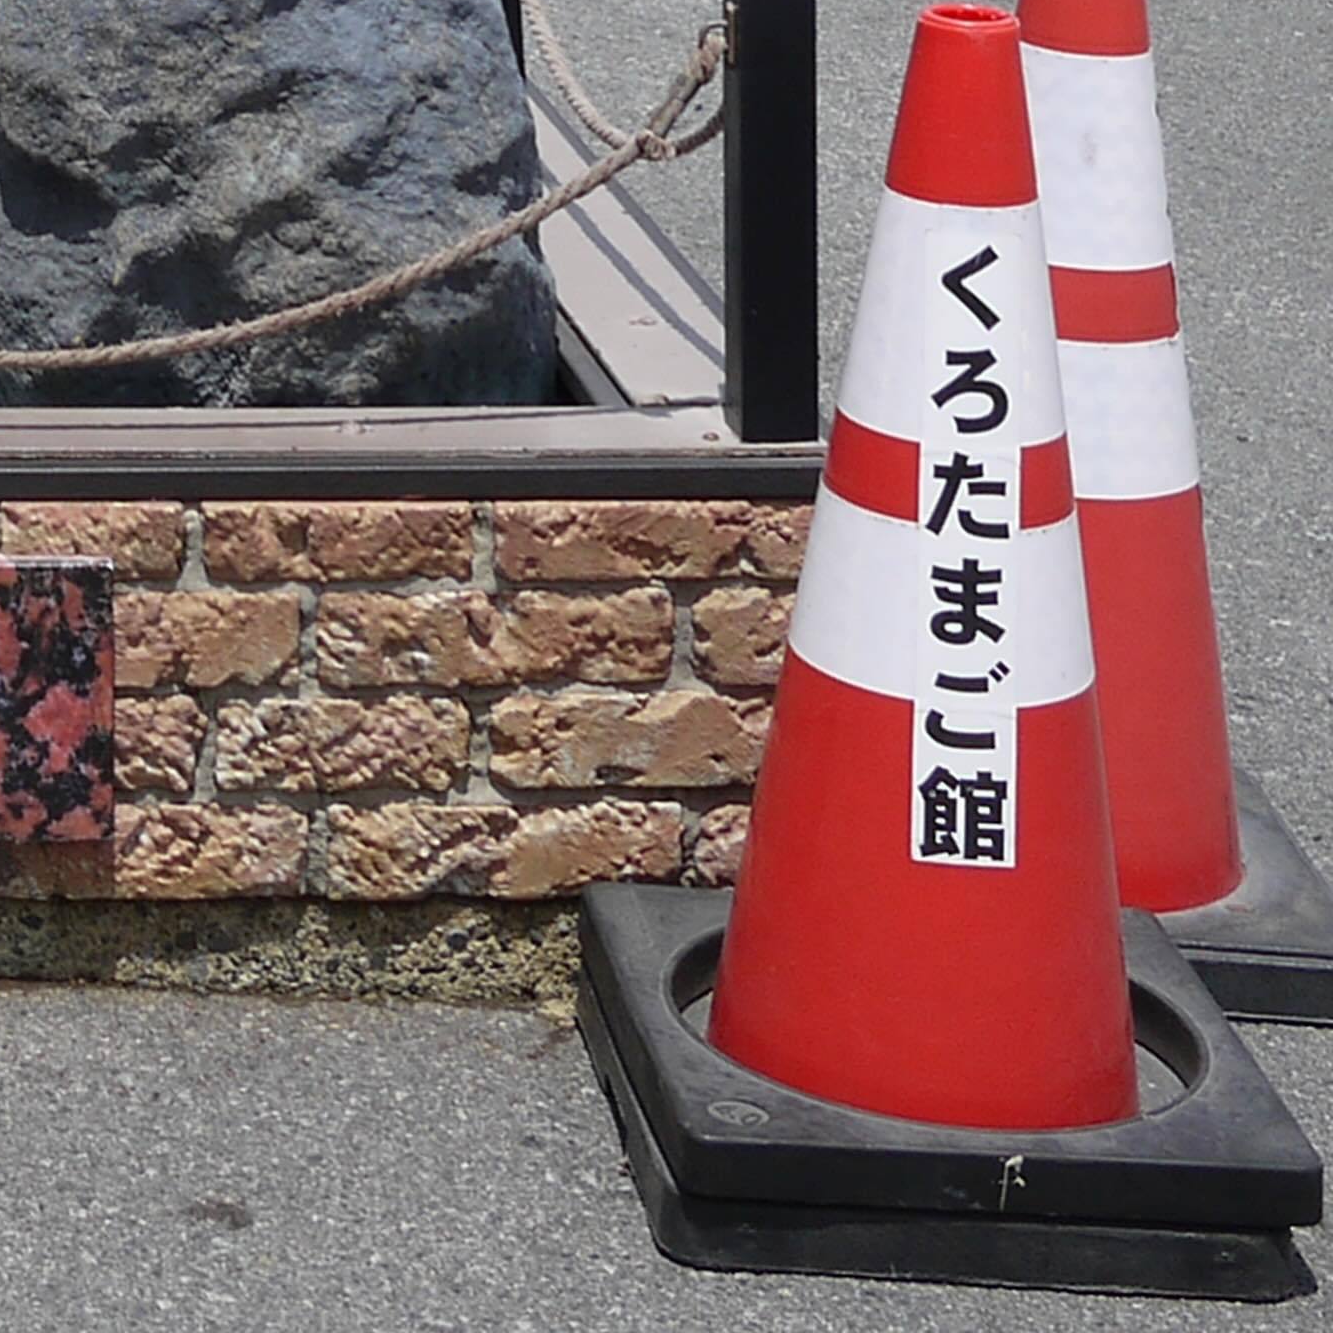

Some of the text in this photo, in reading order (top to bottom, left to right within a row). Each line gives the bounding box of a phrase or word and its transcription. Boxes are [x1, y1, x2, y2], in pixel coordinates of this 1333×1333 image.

[918, 245, 1011, 862] くろたまご館
